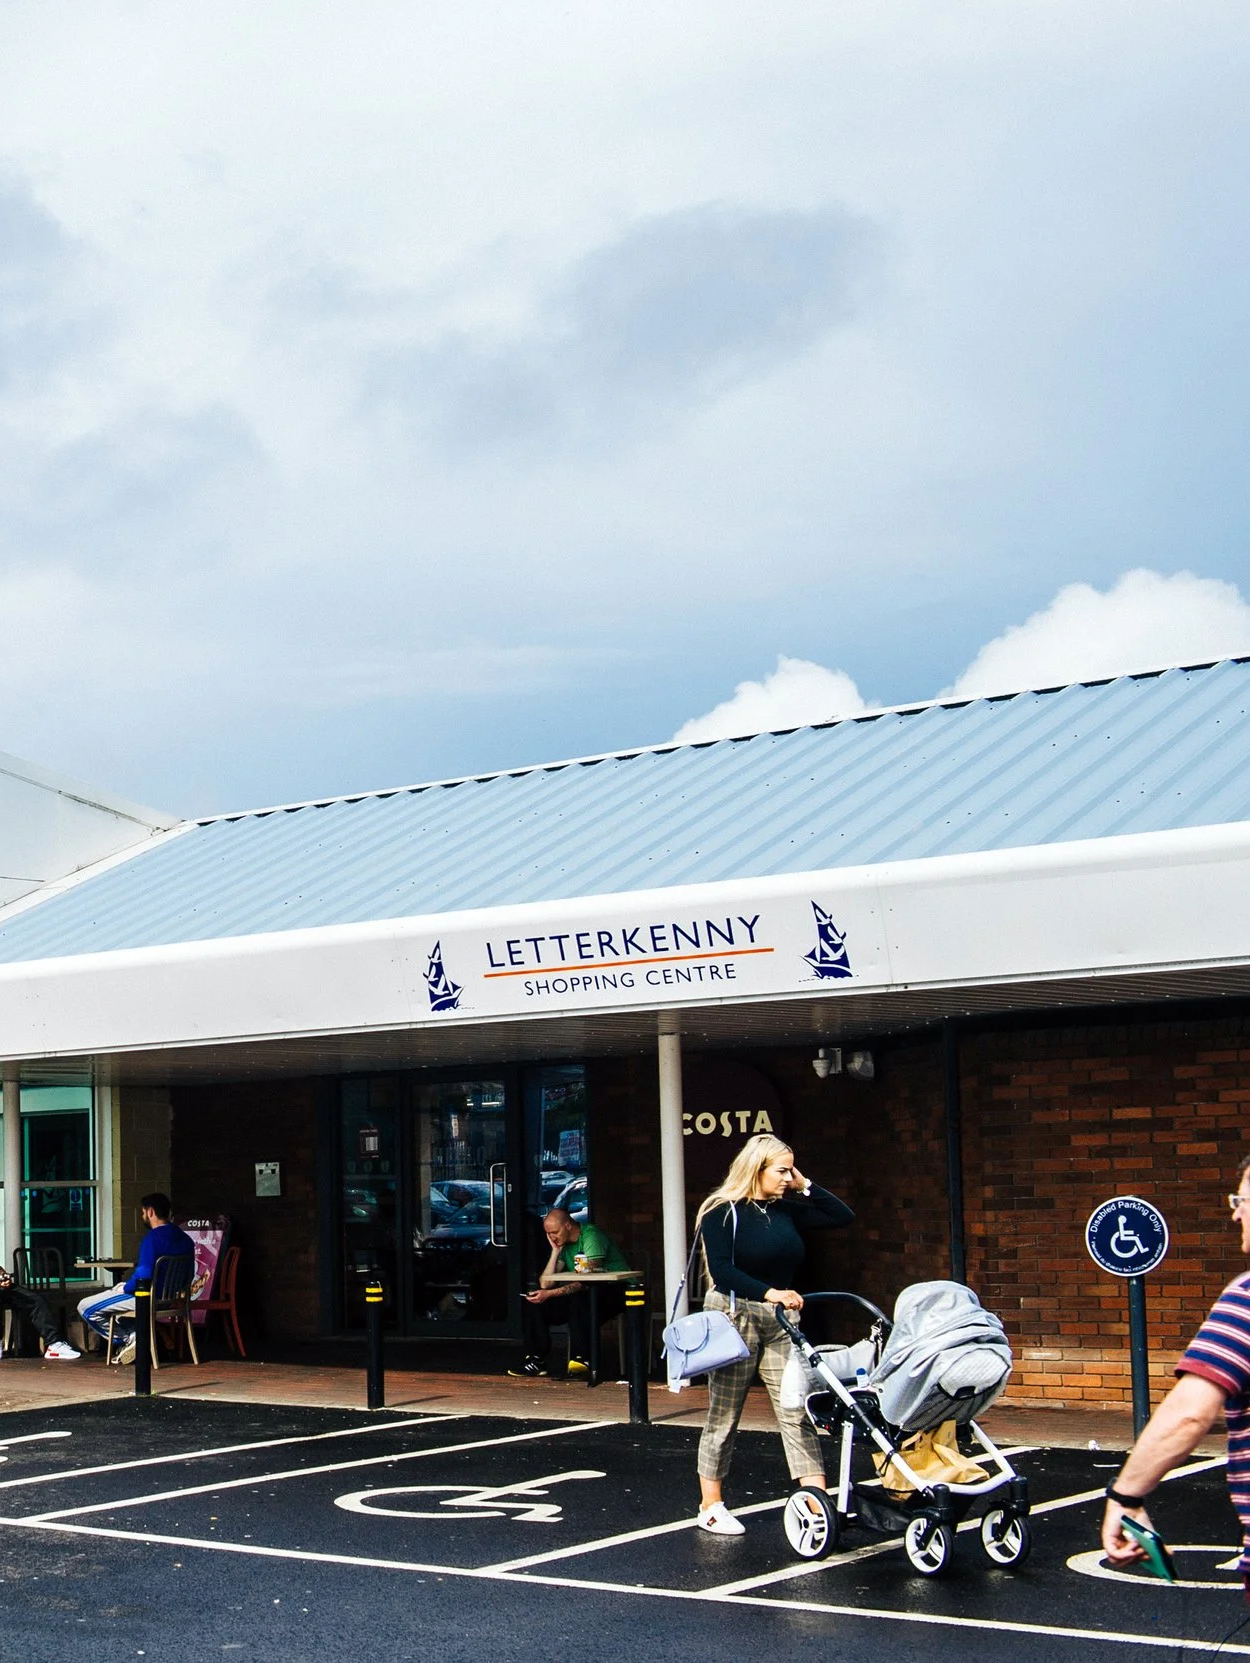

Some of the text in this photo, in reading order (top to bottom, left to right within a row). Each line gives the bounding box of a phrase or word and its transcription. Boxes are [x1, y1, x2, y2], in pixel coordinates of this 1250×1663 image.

[485, 914, 761, 968] LETTERKENNY
[524, 963, 738, 997] SHOPPING CENTRE
[682, 1110, 774, 1138] COSTA
[1090, 1201, 1162, 1233] Disabled Parking Only
